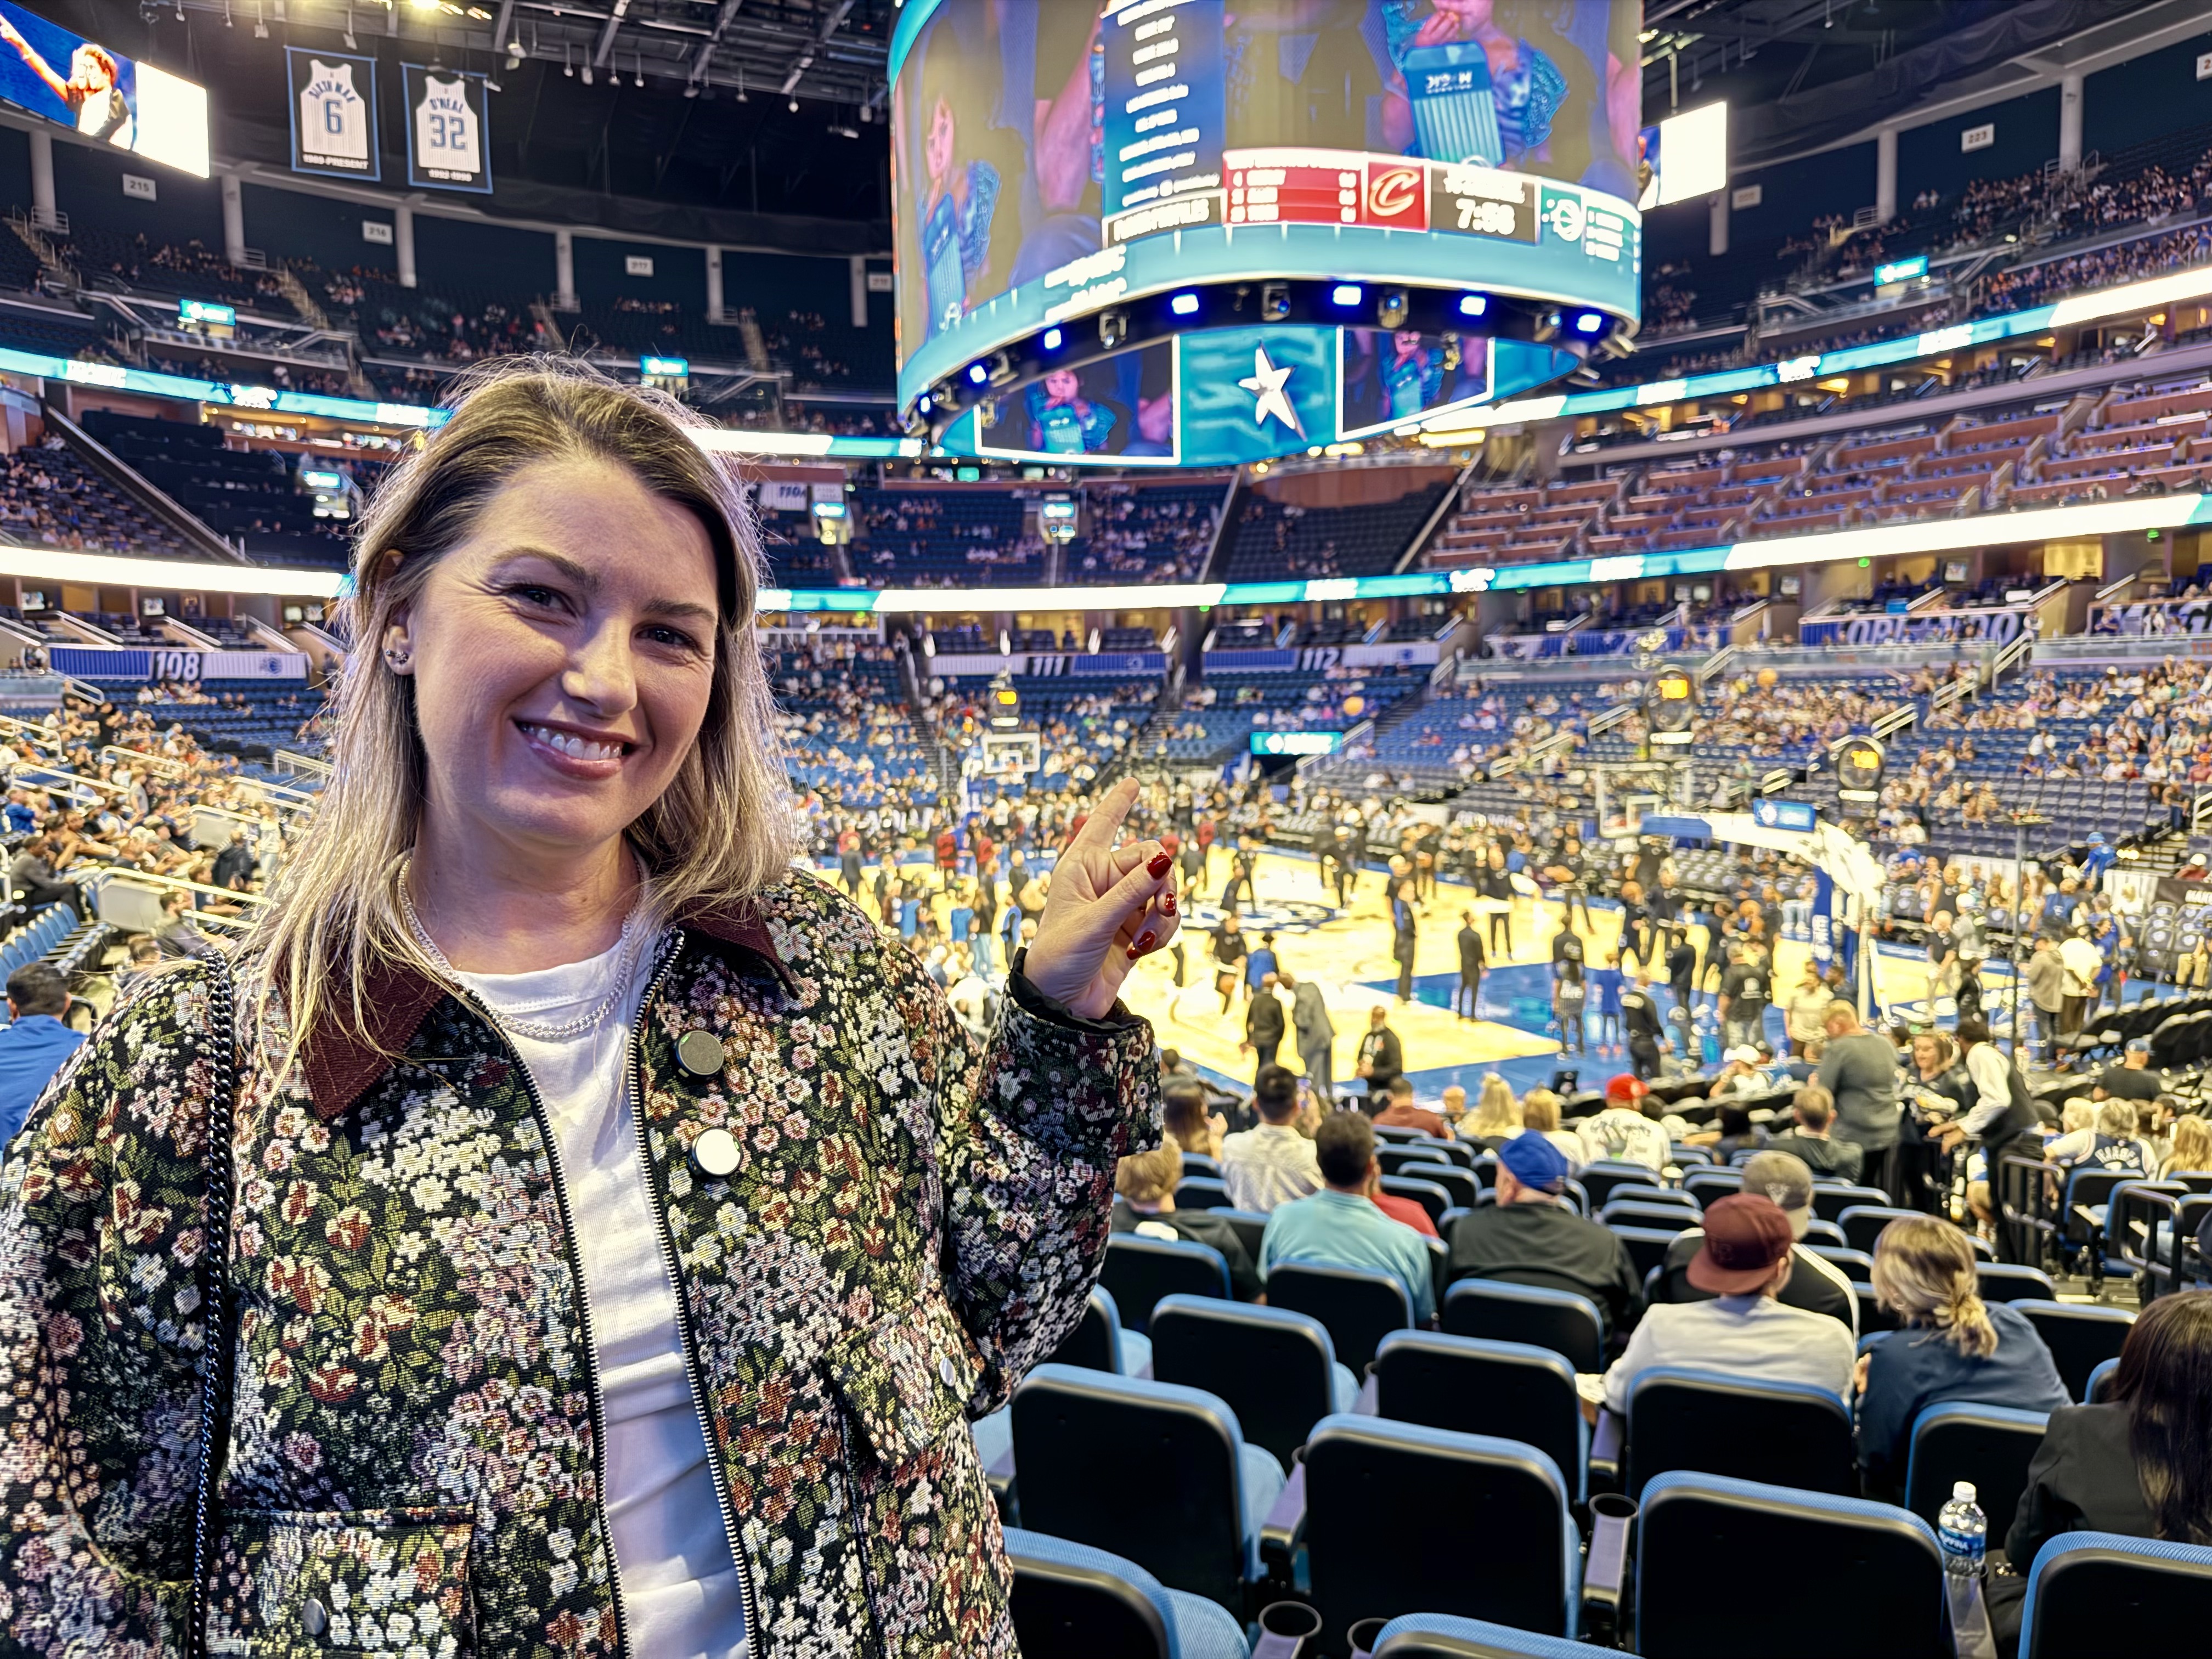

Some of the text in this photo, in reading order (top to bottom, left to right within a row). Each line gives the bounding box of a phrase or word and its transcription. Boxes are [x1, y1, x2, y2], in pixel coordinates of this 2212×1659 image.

[324, 99, 343, 136] 6
[429, 114, 466, 151] 32
[130, 180, 150, 193] 215
[156, 652, 200, 680] 108
[1032, 656, 1065, 677] 111
[1302, 647, 1339, 671] 112
